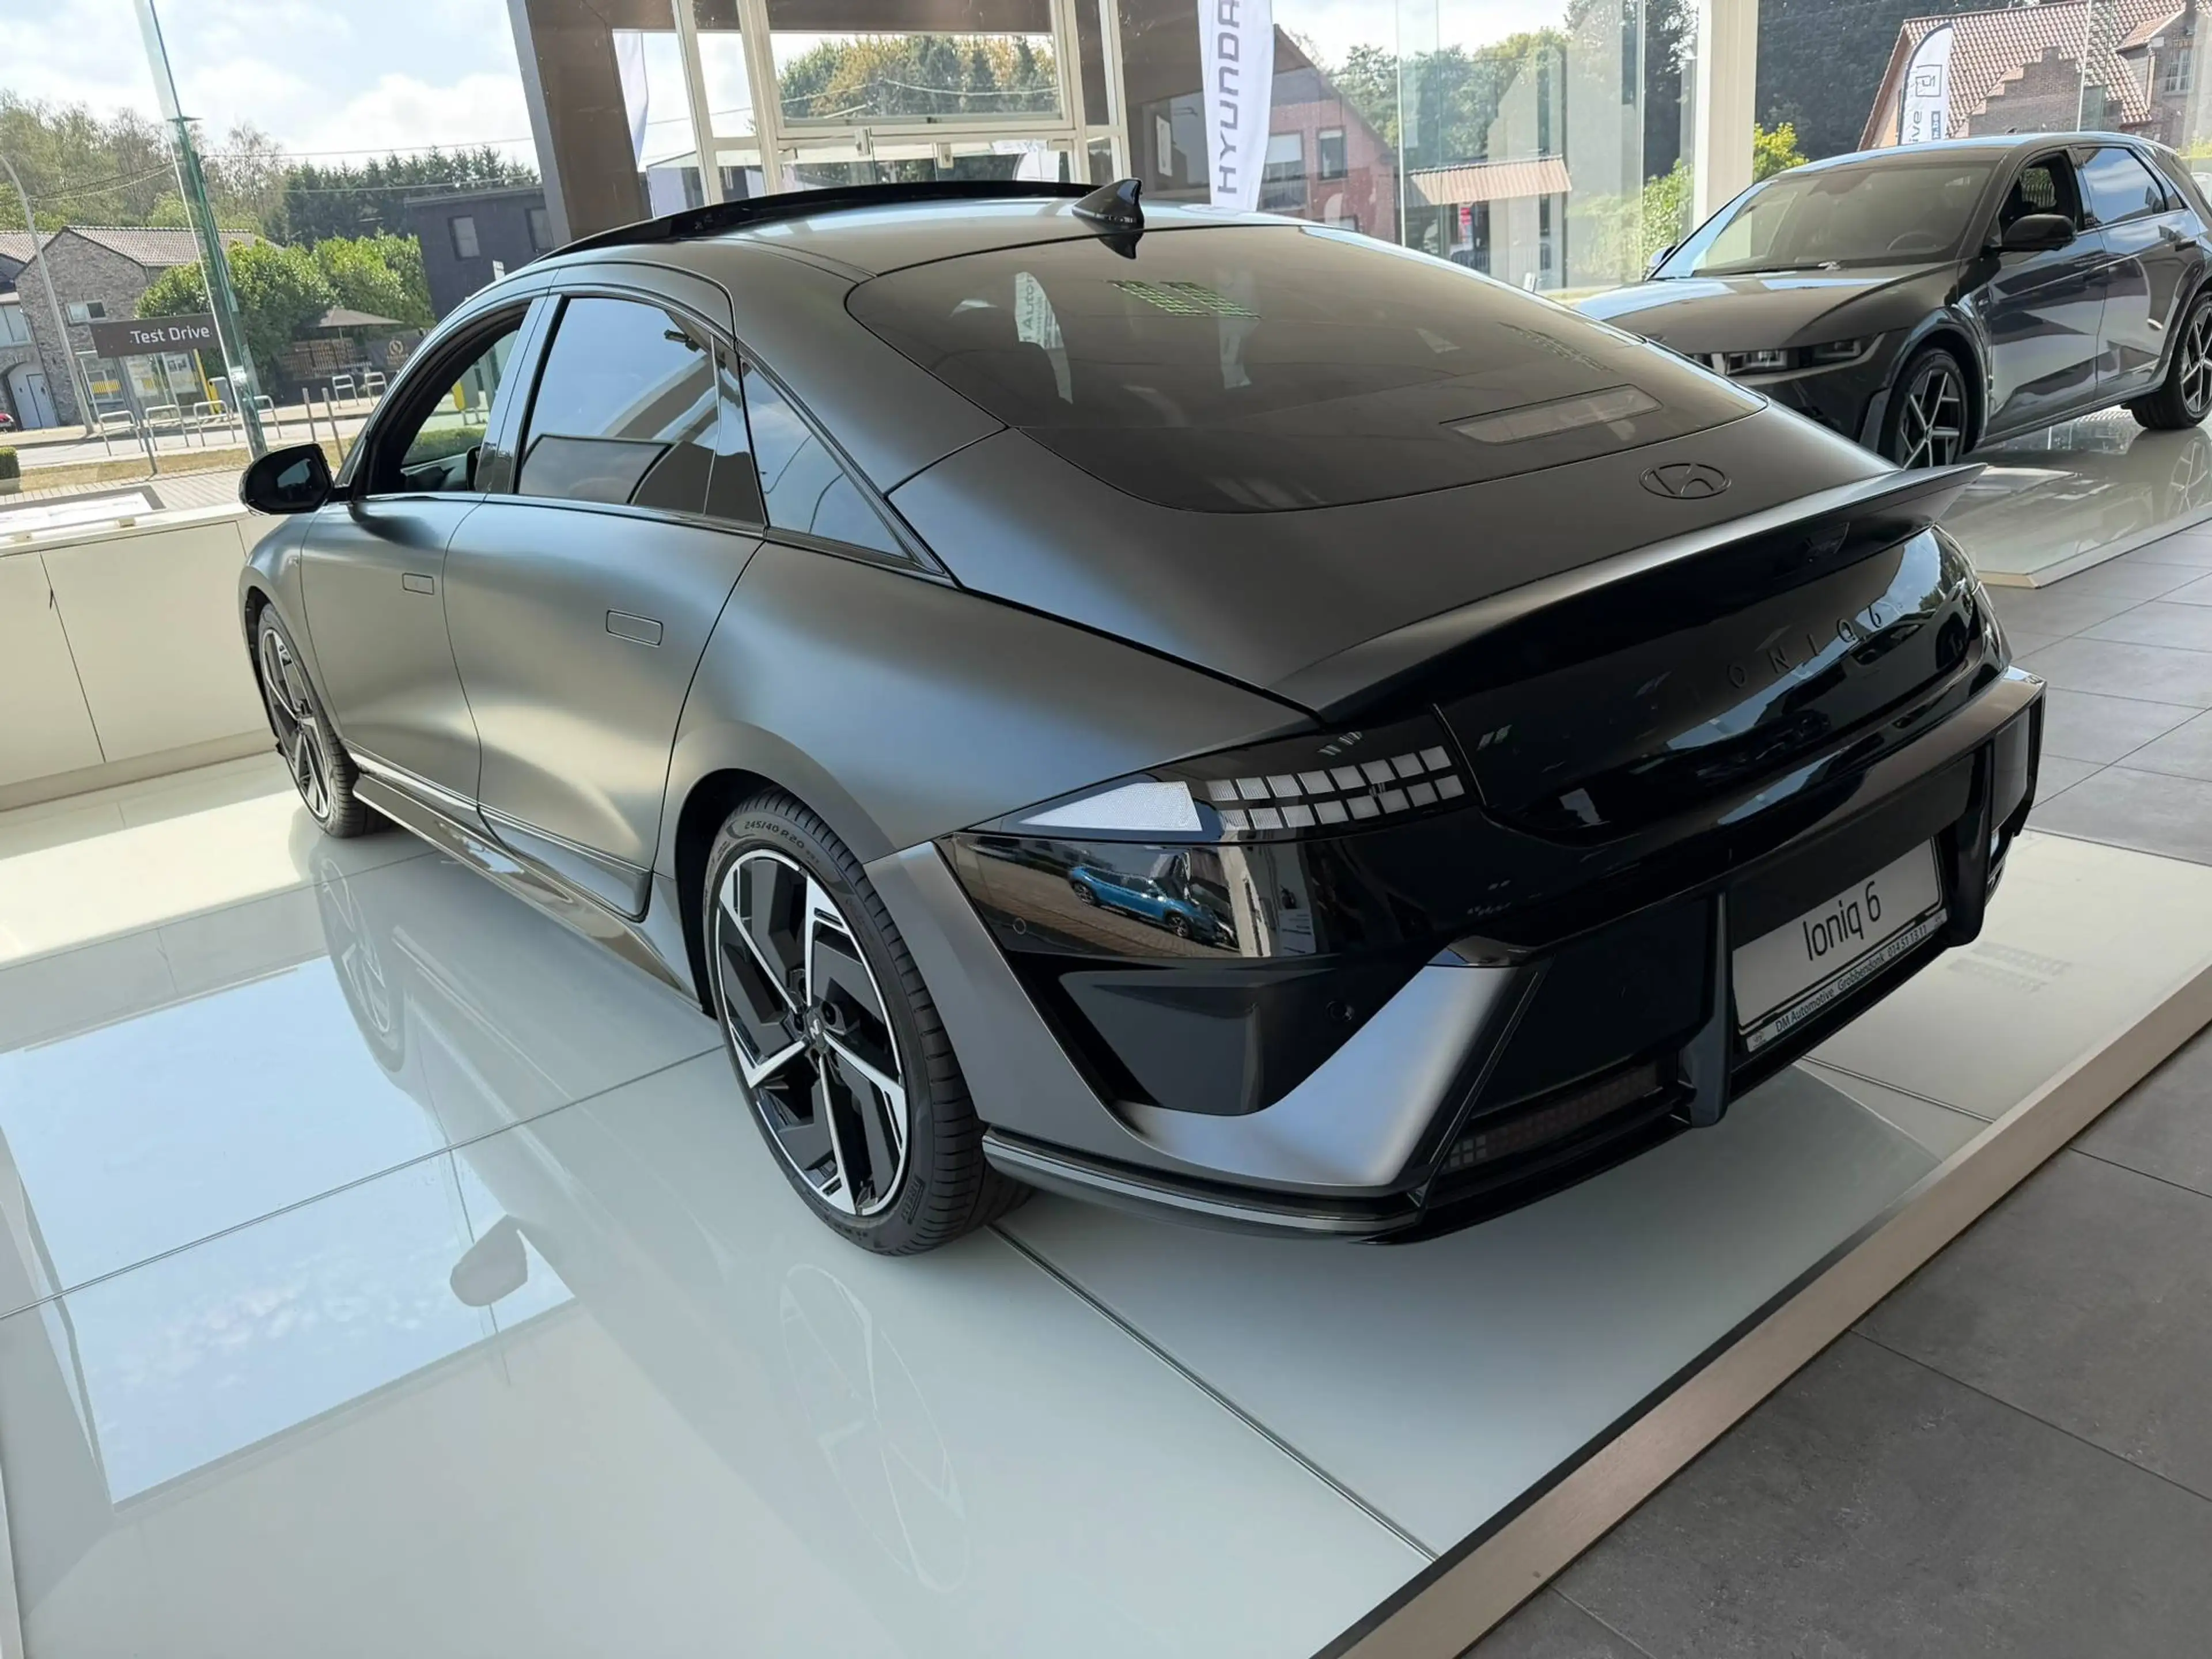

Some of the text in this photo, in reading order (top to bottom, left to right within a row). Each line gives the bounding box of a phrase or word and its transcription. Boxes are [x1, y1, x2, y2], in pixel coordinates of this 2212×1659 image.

[130, 325, 210, 344] Test Drive
[744, 820, 779, 835] 245/40
[1802, 880, 1881, 961] Ioniq 6
[1775, 1017, 1791, 1033] DM
[1791, 988, 1835, 1024] Automotive
